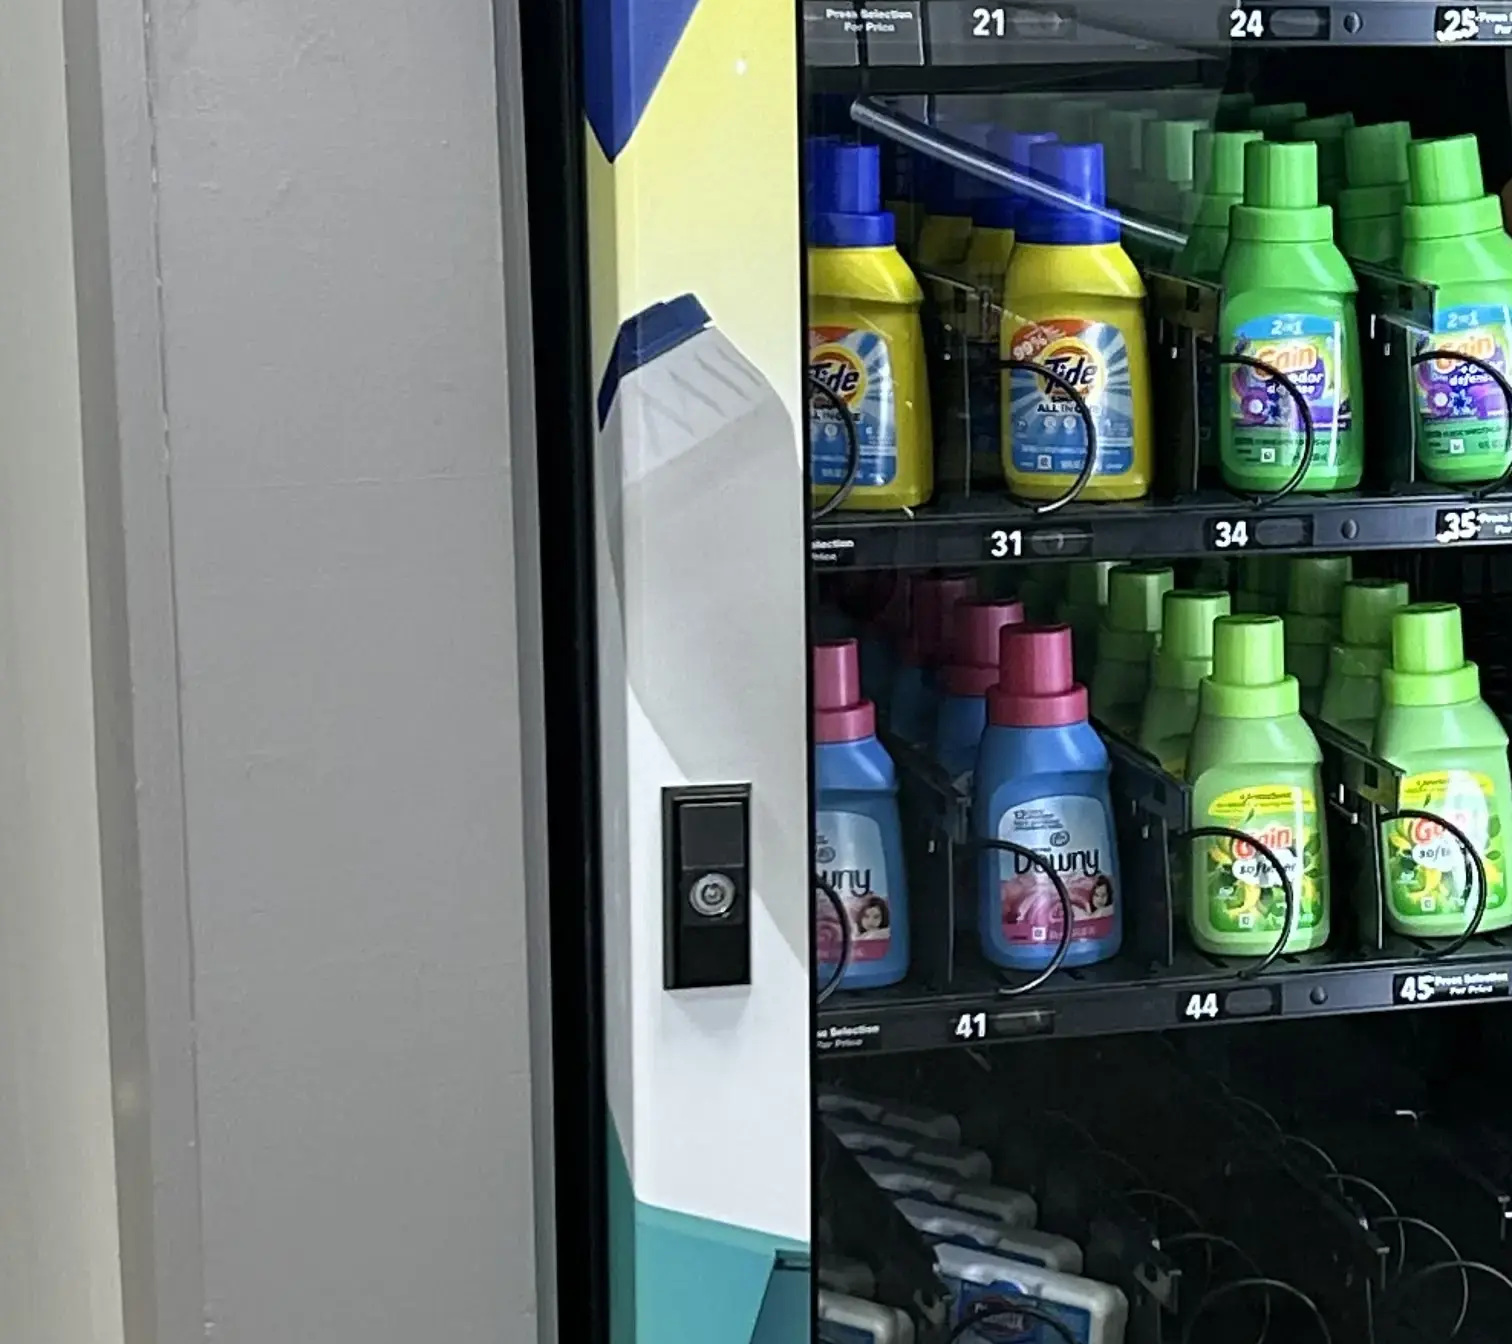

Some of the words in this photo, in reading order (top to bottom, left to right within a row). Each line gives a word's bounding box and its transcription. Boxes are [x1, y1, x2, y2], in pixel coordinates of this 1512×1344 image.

[825, 8, 858, 19] Press
[860, 8, 913, 20] Selection
[844, 21, 863, 32] For
[865, 21, 895, 32] Price
[972, 9, 1005, 36] 21
[1230, 9, 1264, 38] 24
[1437, 8, 1479, 41] 25
[1044, 356, 1099, 395] Tide
[1214, 521, 1249, 548] 34
[1437, 510, 1477, 543] 35
[990, 530, 1022, 557] 31
[1014, 849, 1101, 878] Downy
[1240, 862, 1297, 878] softeer
[820, 868, 873, 897] wny
[1401, 975, 1435, 1002] 45
[1185, 993, 1219, 1019] 44
[830, 1025, 880, 1038] Selection
[954, 1013, 988, 1038] 41
